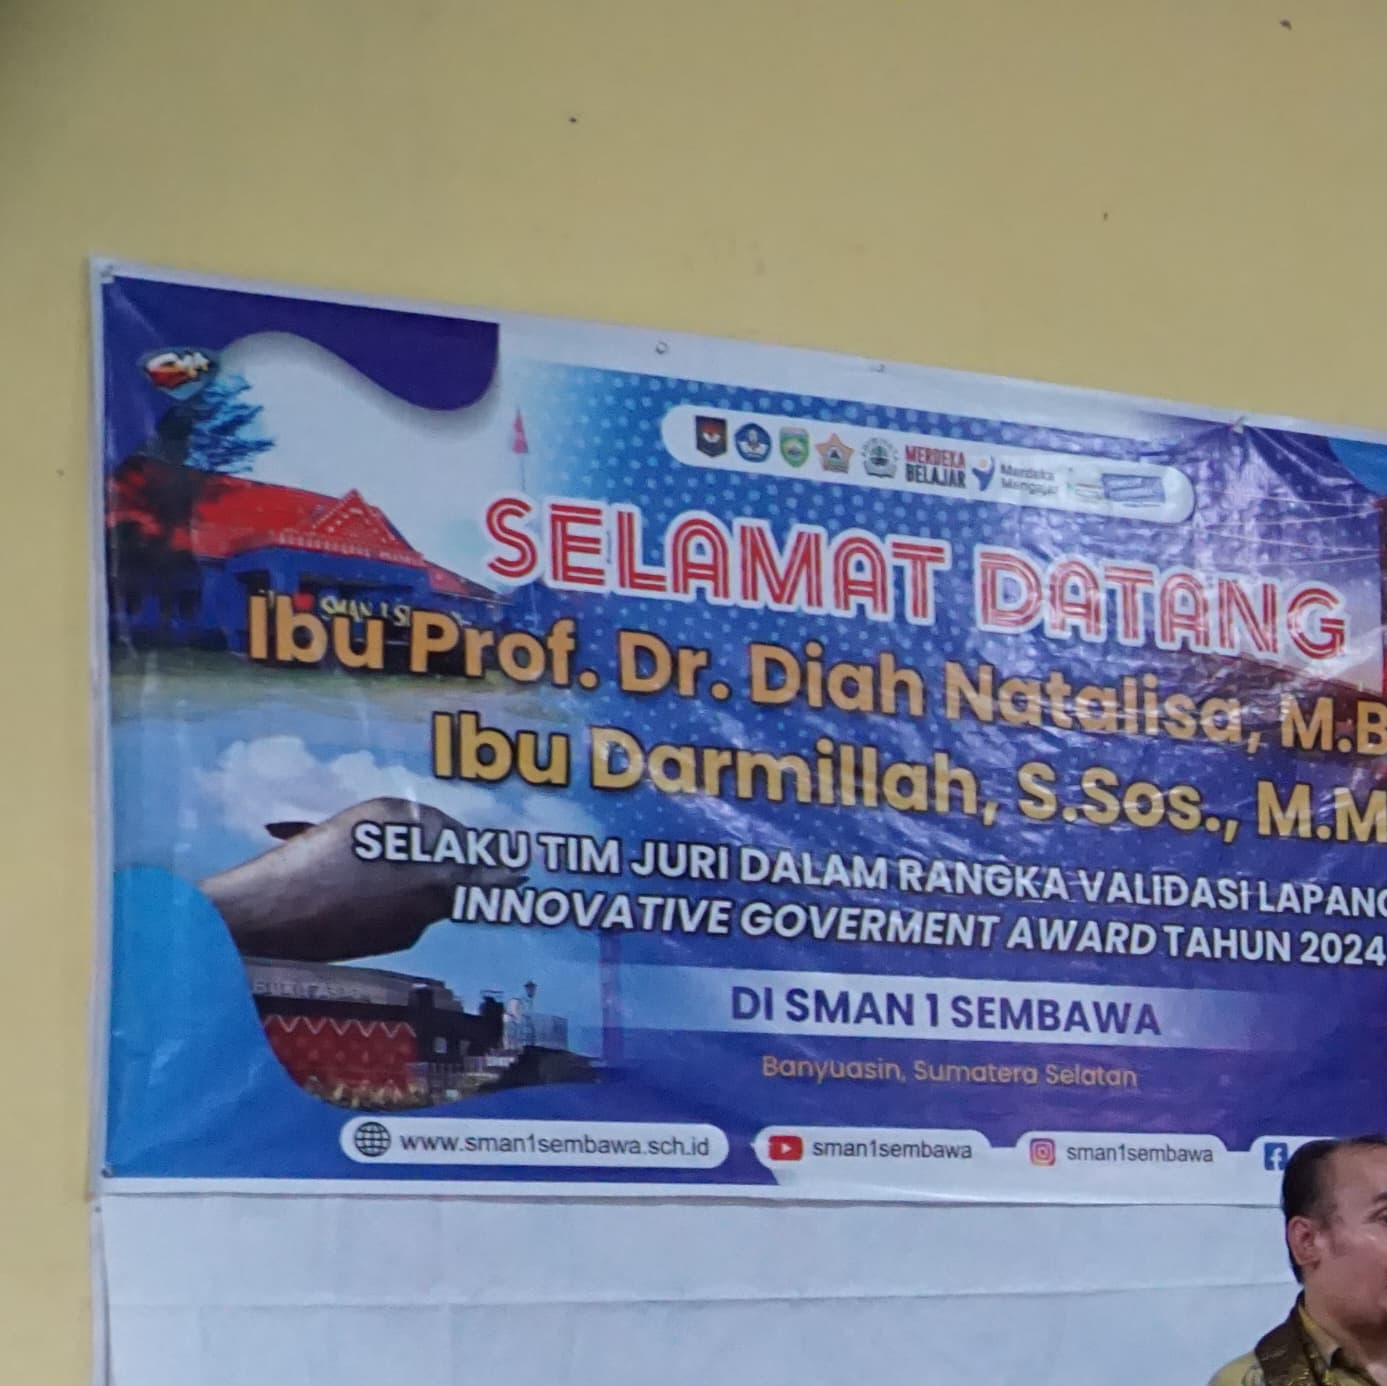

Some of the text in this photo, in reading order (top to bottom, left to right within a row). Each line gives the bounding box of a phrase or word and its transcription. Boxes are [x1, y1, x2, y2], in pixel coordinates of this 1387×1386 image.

[905, 445, 966, 468] MERDEKA
[905, 463, 966, 488] BELAJAR
[485, 497, 1347, 661] SELAMAT DATANG
[248, 594, 385, 670] Ibu
[409, 610, 599, 690] Prof.
[619, 630, 731, 701] Dr.
[749, 640, 925, 718] Diah
[943, 660, 1260, 754] Natalisa,
[431, 711, 570, 786] Ibu
[590, 725, 998, 826] Darmillah,
[1017, 760, 1239, 843] S.Sos.,
[353, 822, 530, 869] SELAKU
[538, 834, 621, 874] TIM
[631, 841, 728, 880] JURI
[739, 847, 889, 890] DALAM
[900, 858, 1069, 900] RANGKA
[1078, 869, 1250, 911] VALIDASI
[451, 886, 1387, 967] INNOVATIVE GOVERMENT AWARD TAHUN 2024
[731, 986, 1162, 1036] DI SMAN 1 SEMBAWA
[762, 1055, 1138, 1088] Banyuasin, Sumatera Selatan
[400, 1132, 710, 1157] www.sman1sembawa.sch.id
[812, 1138, 972, 1160] sman1sembawa
[1066, 1142, 1214, 1164] sman1sembawa
